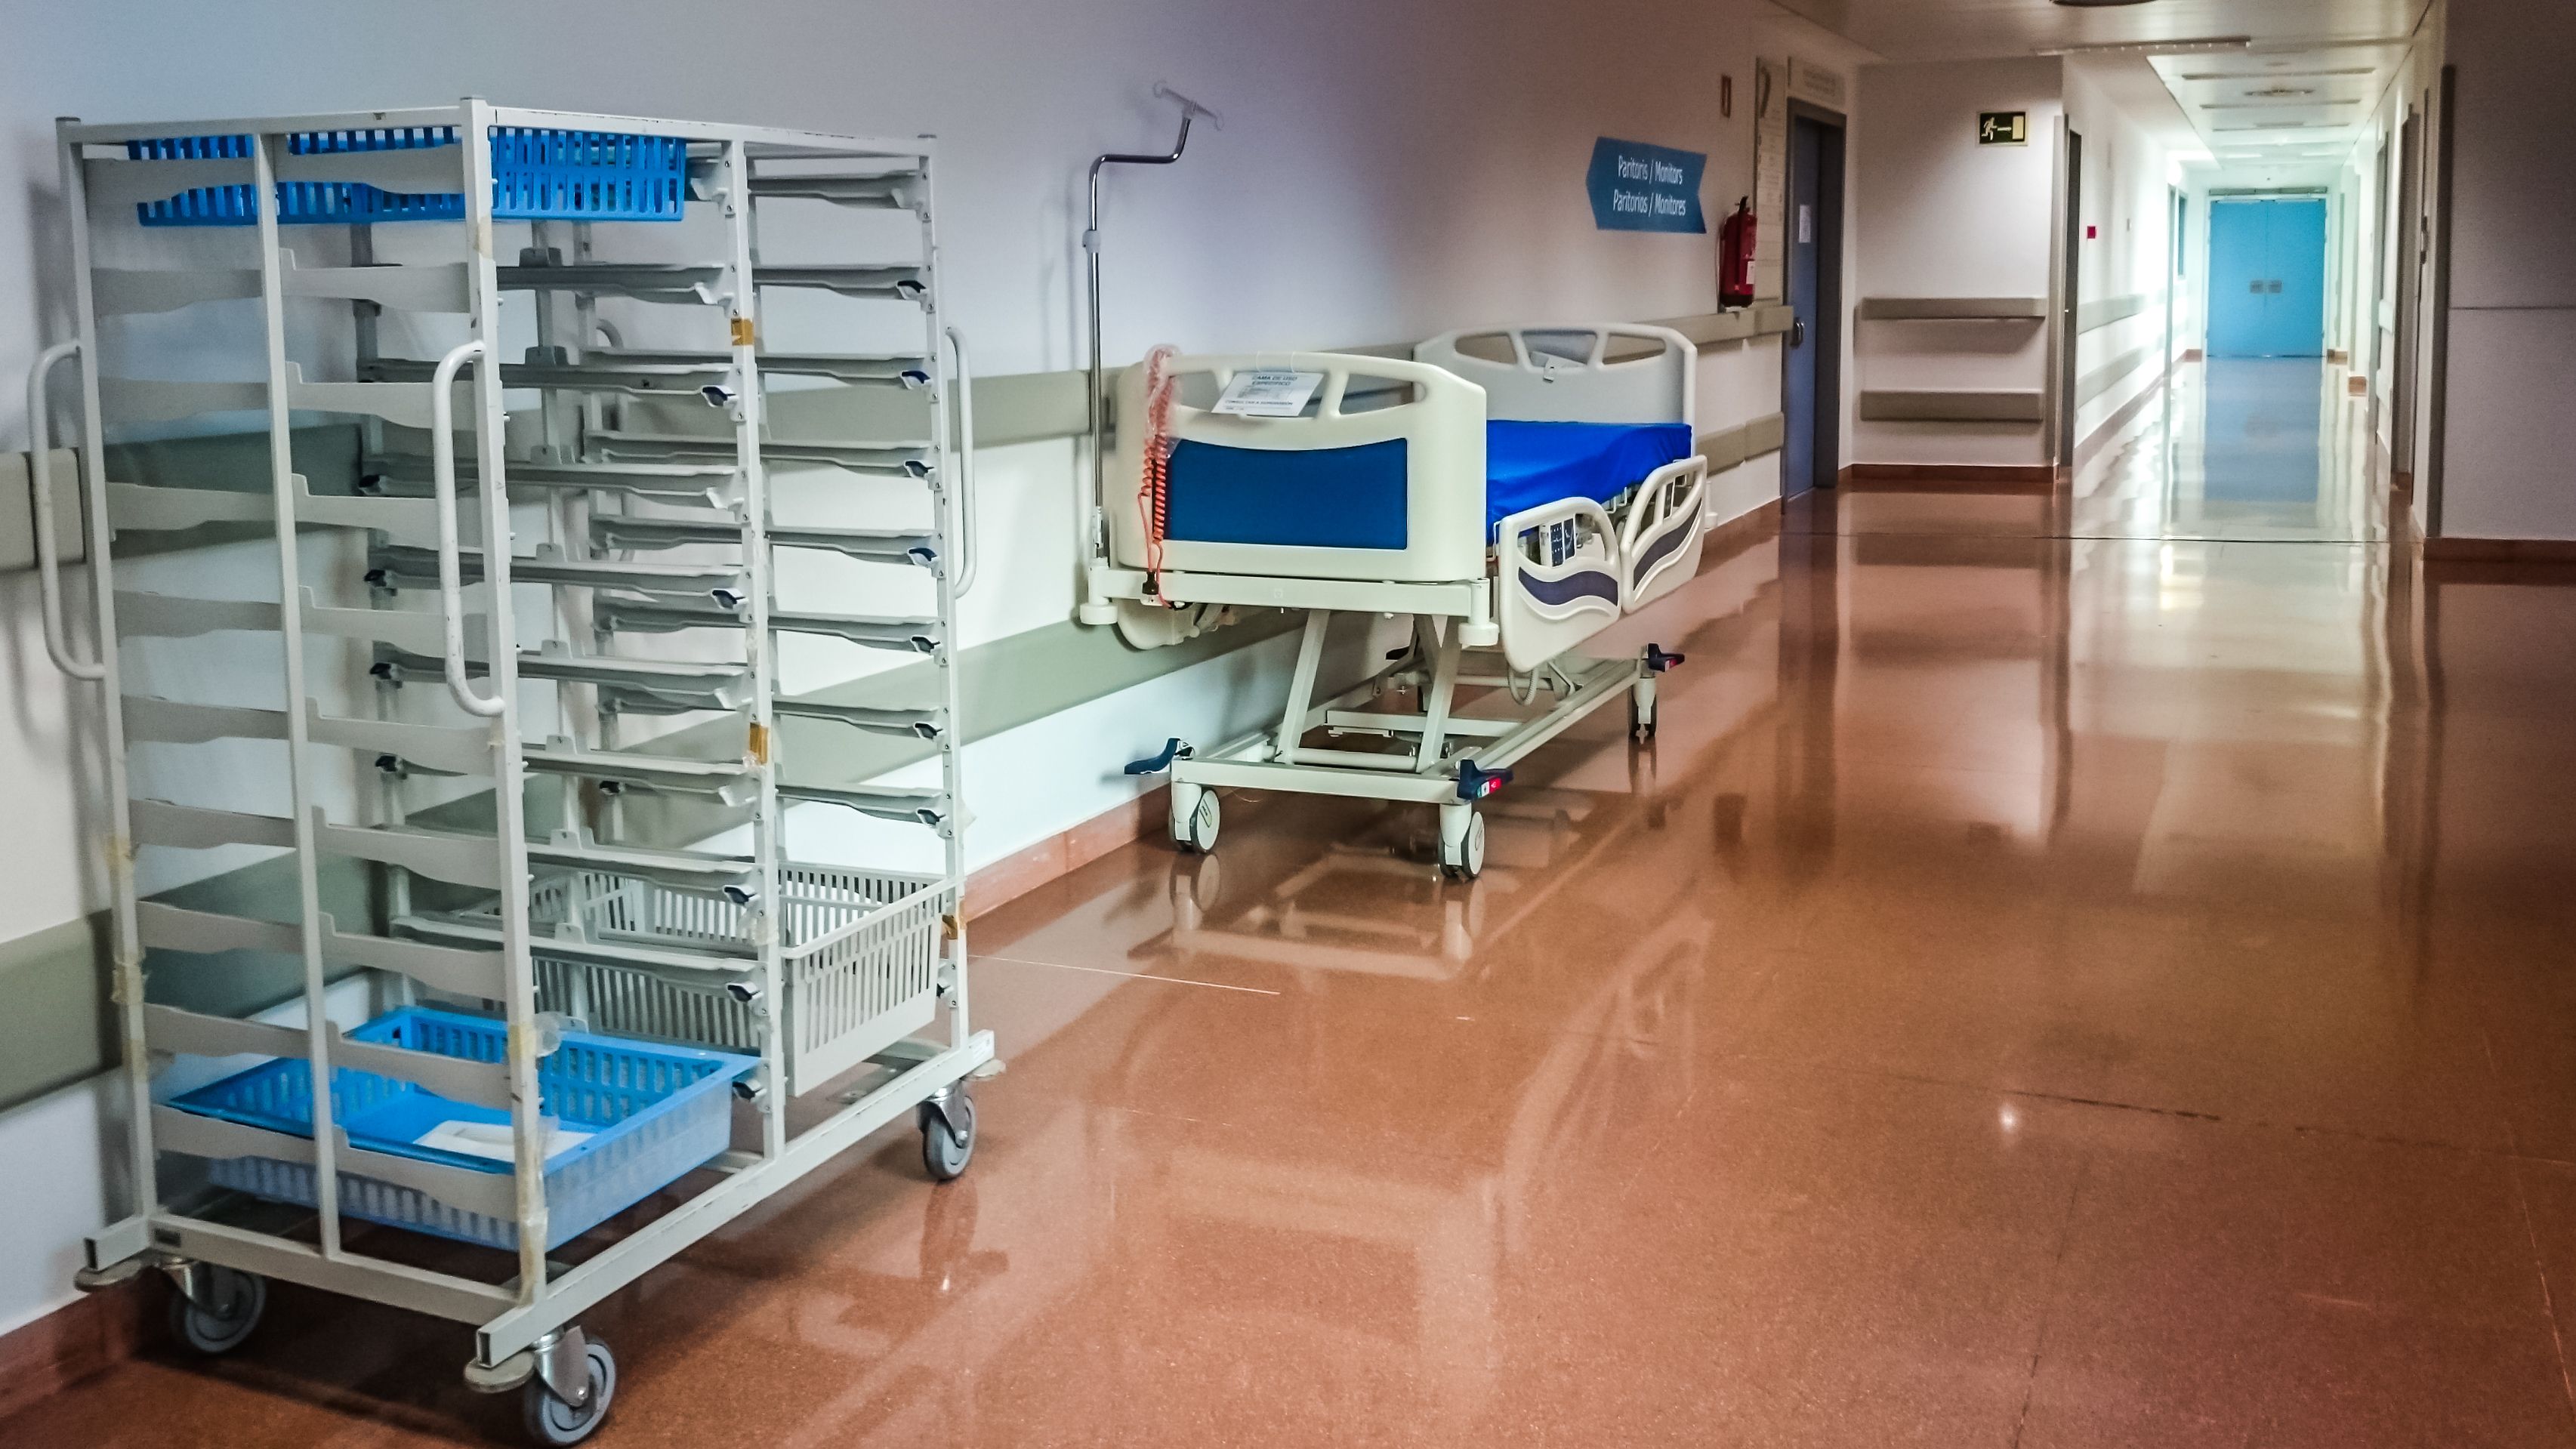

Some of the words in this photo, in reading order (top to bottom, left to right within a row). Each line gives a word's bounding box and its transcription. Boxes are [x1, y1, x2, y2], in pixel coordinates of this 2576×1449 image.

[1618, 154, 1648, 180] Paritoris
[1649, 159, 1654, 185] /
[1655, 160, 1683, 185] Monitors
[1612, 188, 1648, 214] Paritorios
[1648, 192, 1654, 217] /
[1655, 193, 1686, 216] Monitores
